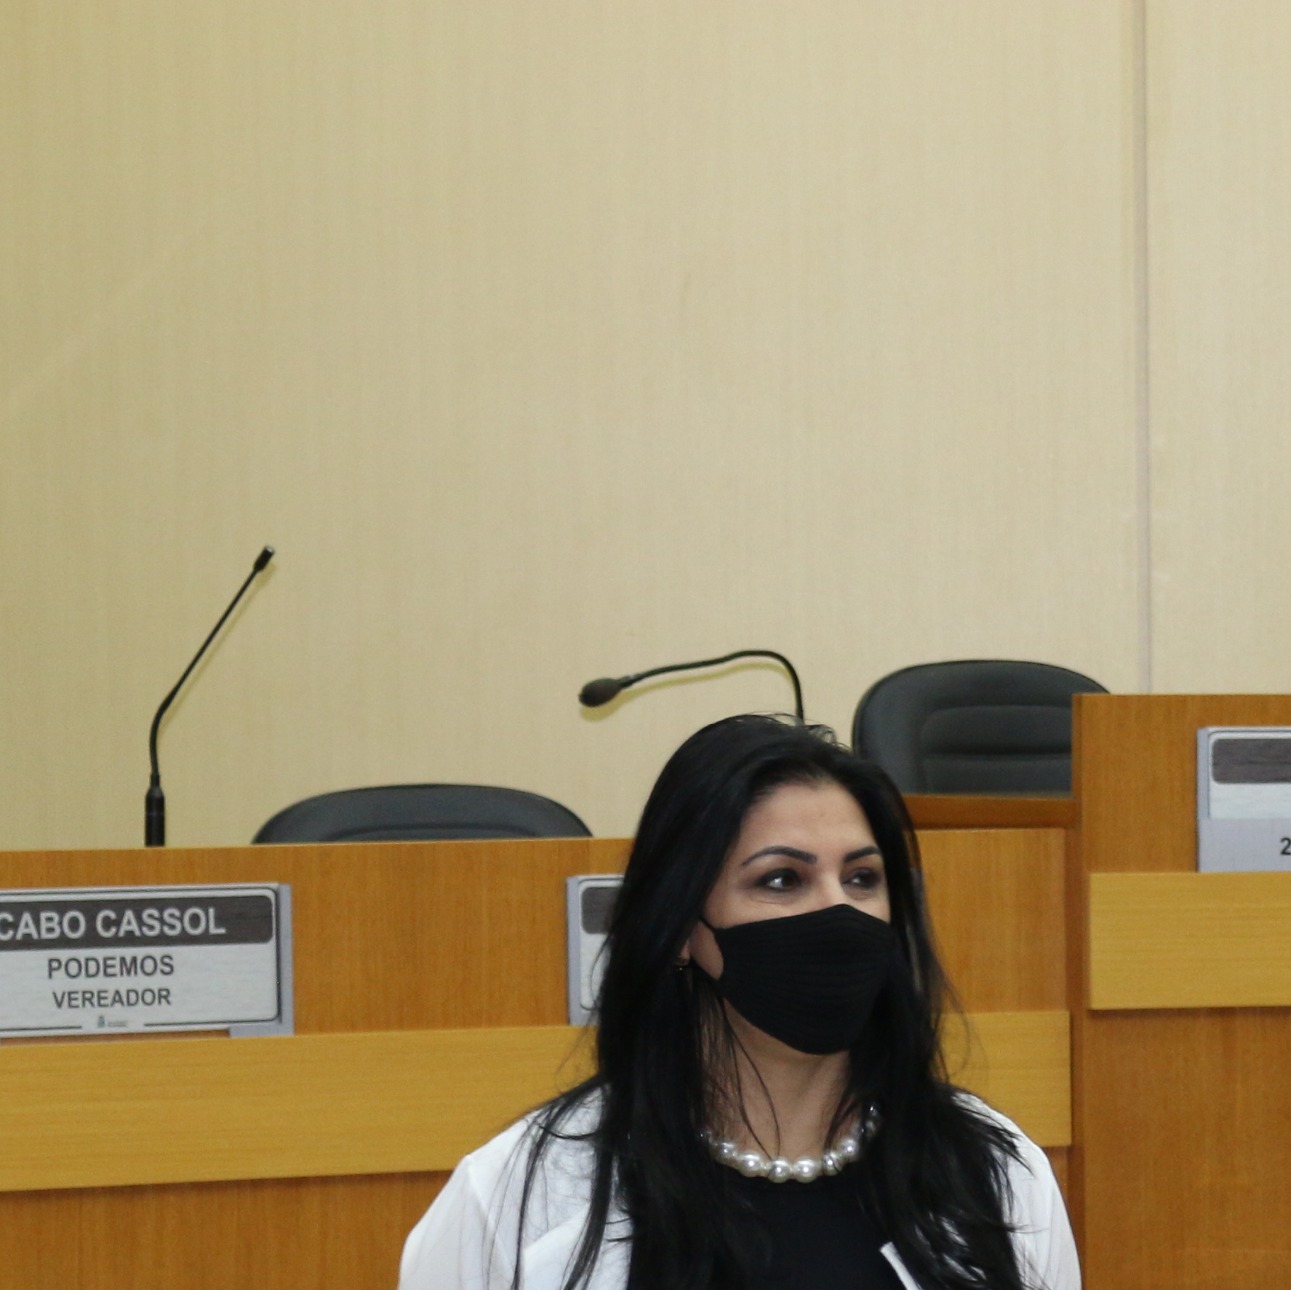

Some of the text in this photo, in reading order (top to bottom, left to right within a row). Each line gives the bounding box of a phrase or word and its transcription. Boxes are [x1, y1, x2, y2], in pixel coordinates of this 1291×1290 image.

[0, 907, 227, 942] CABO CASSOL
[47, 954, 175, 980] PODEMOS
[52, 987, 172, 1010] VEREADOR
